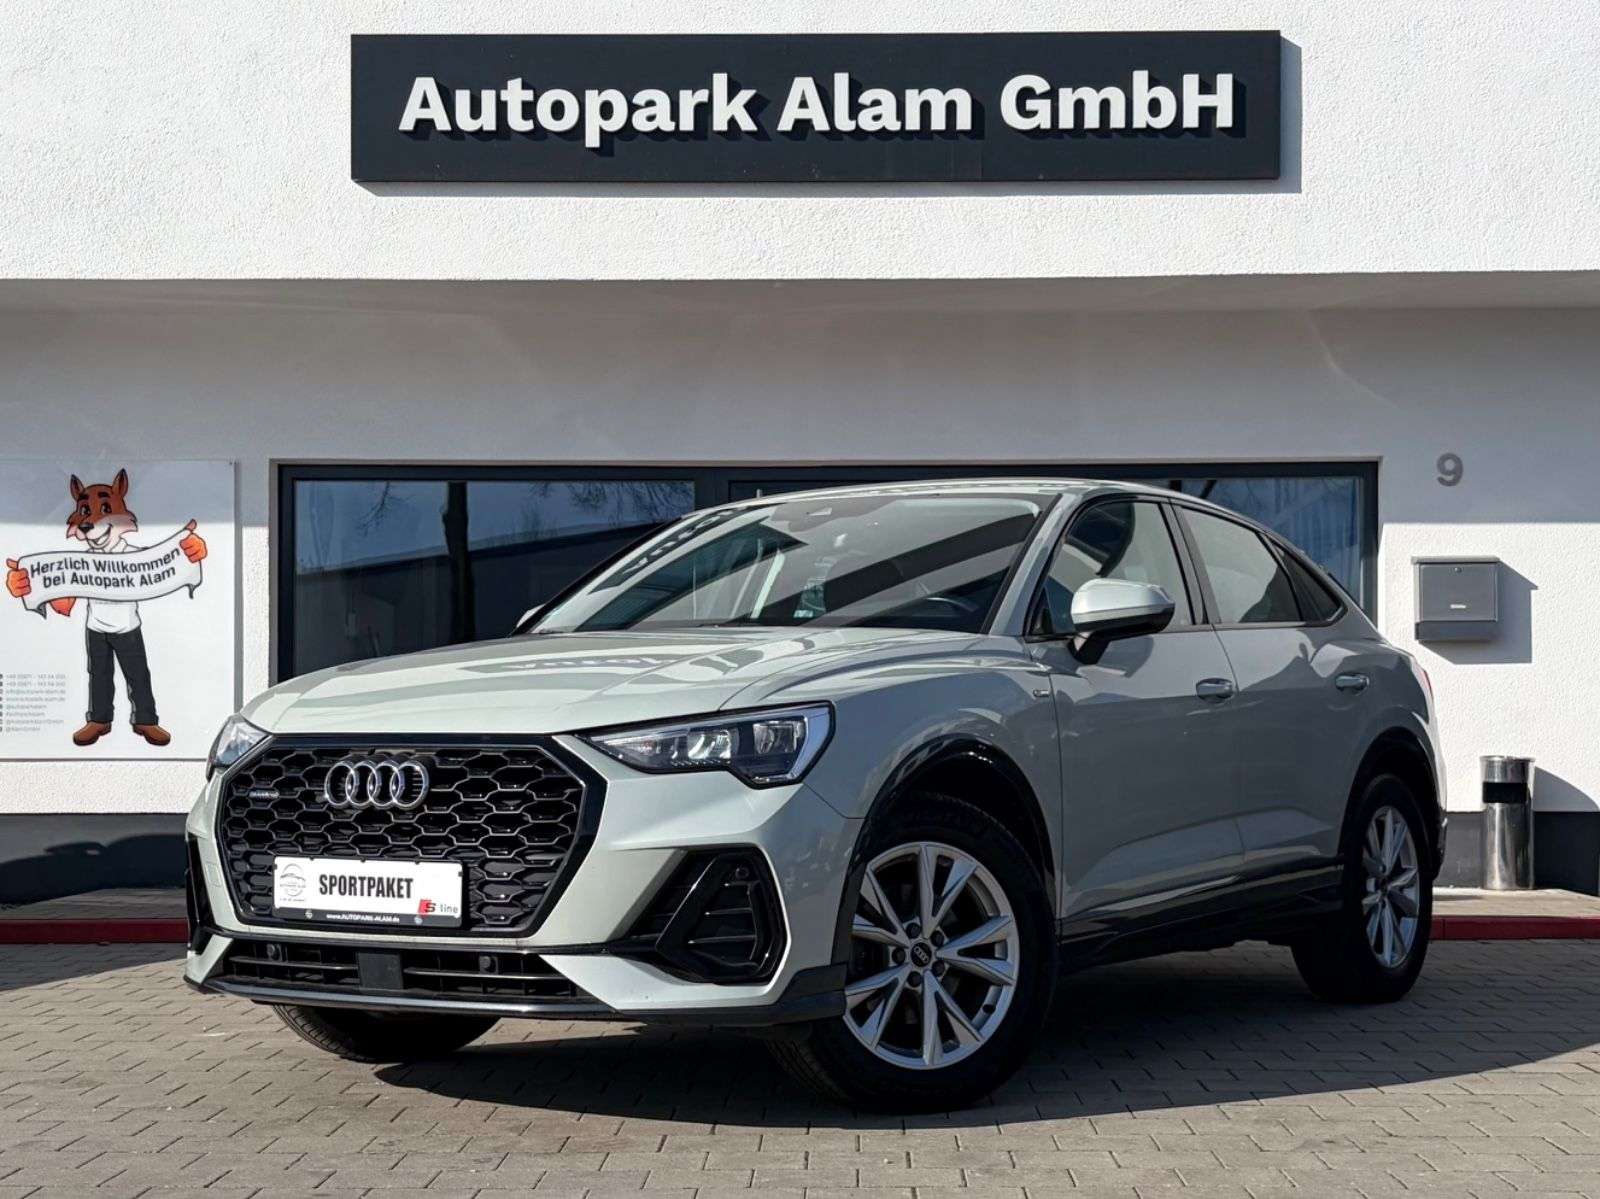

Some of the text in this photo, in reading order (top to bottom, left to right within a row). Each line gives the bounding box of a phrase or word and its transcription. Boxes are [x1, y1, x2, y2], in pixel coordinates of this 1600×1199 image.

[399, 70, 1234, 148] Autopark Alam GmbH
[1436, 452, 1464, 487] 9
[30, 547, 181, 578] Herzlich Willkommen
[43, 566, 176, 588] bei Autopark Alam
[318, 873, 414, 899] SPORTPAKET
[440, 903, 459, 914] line
